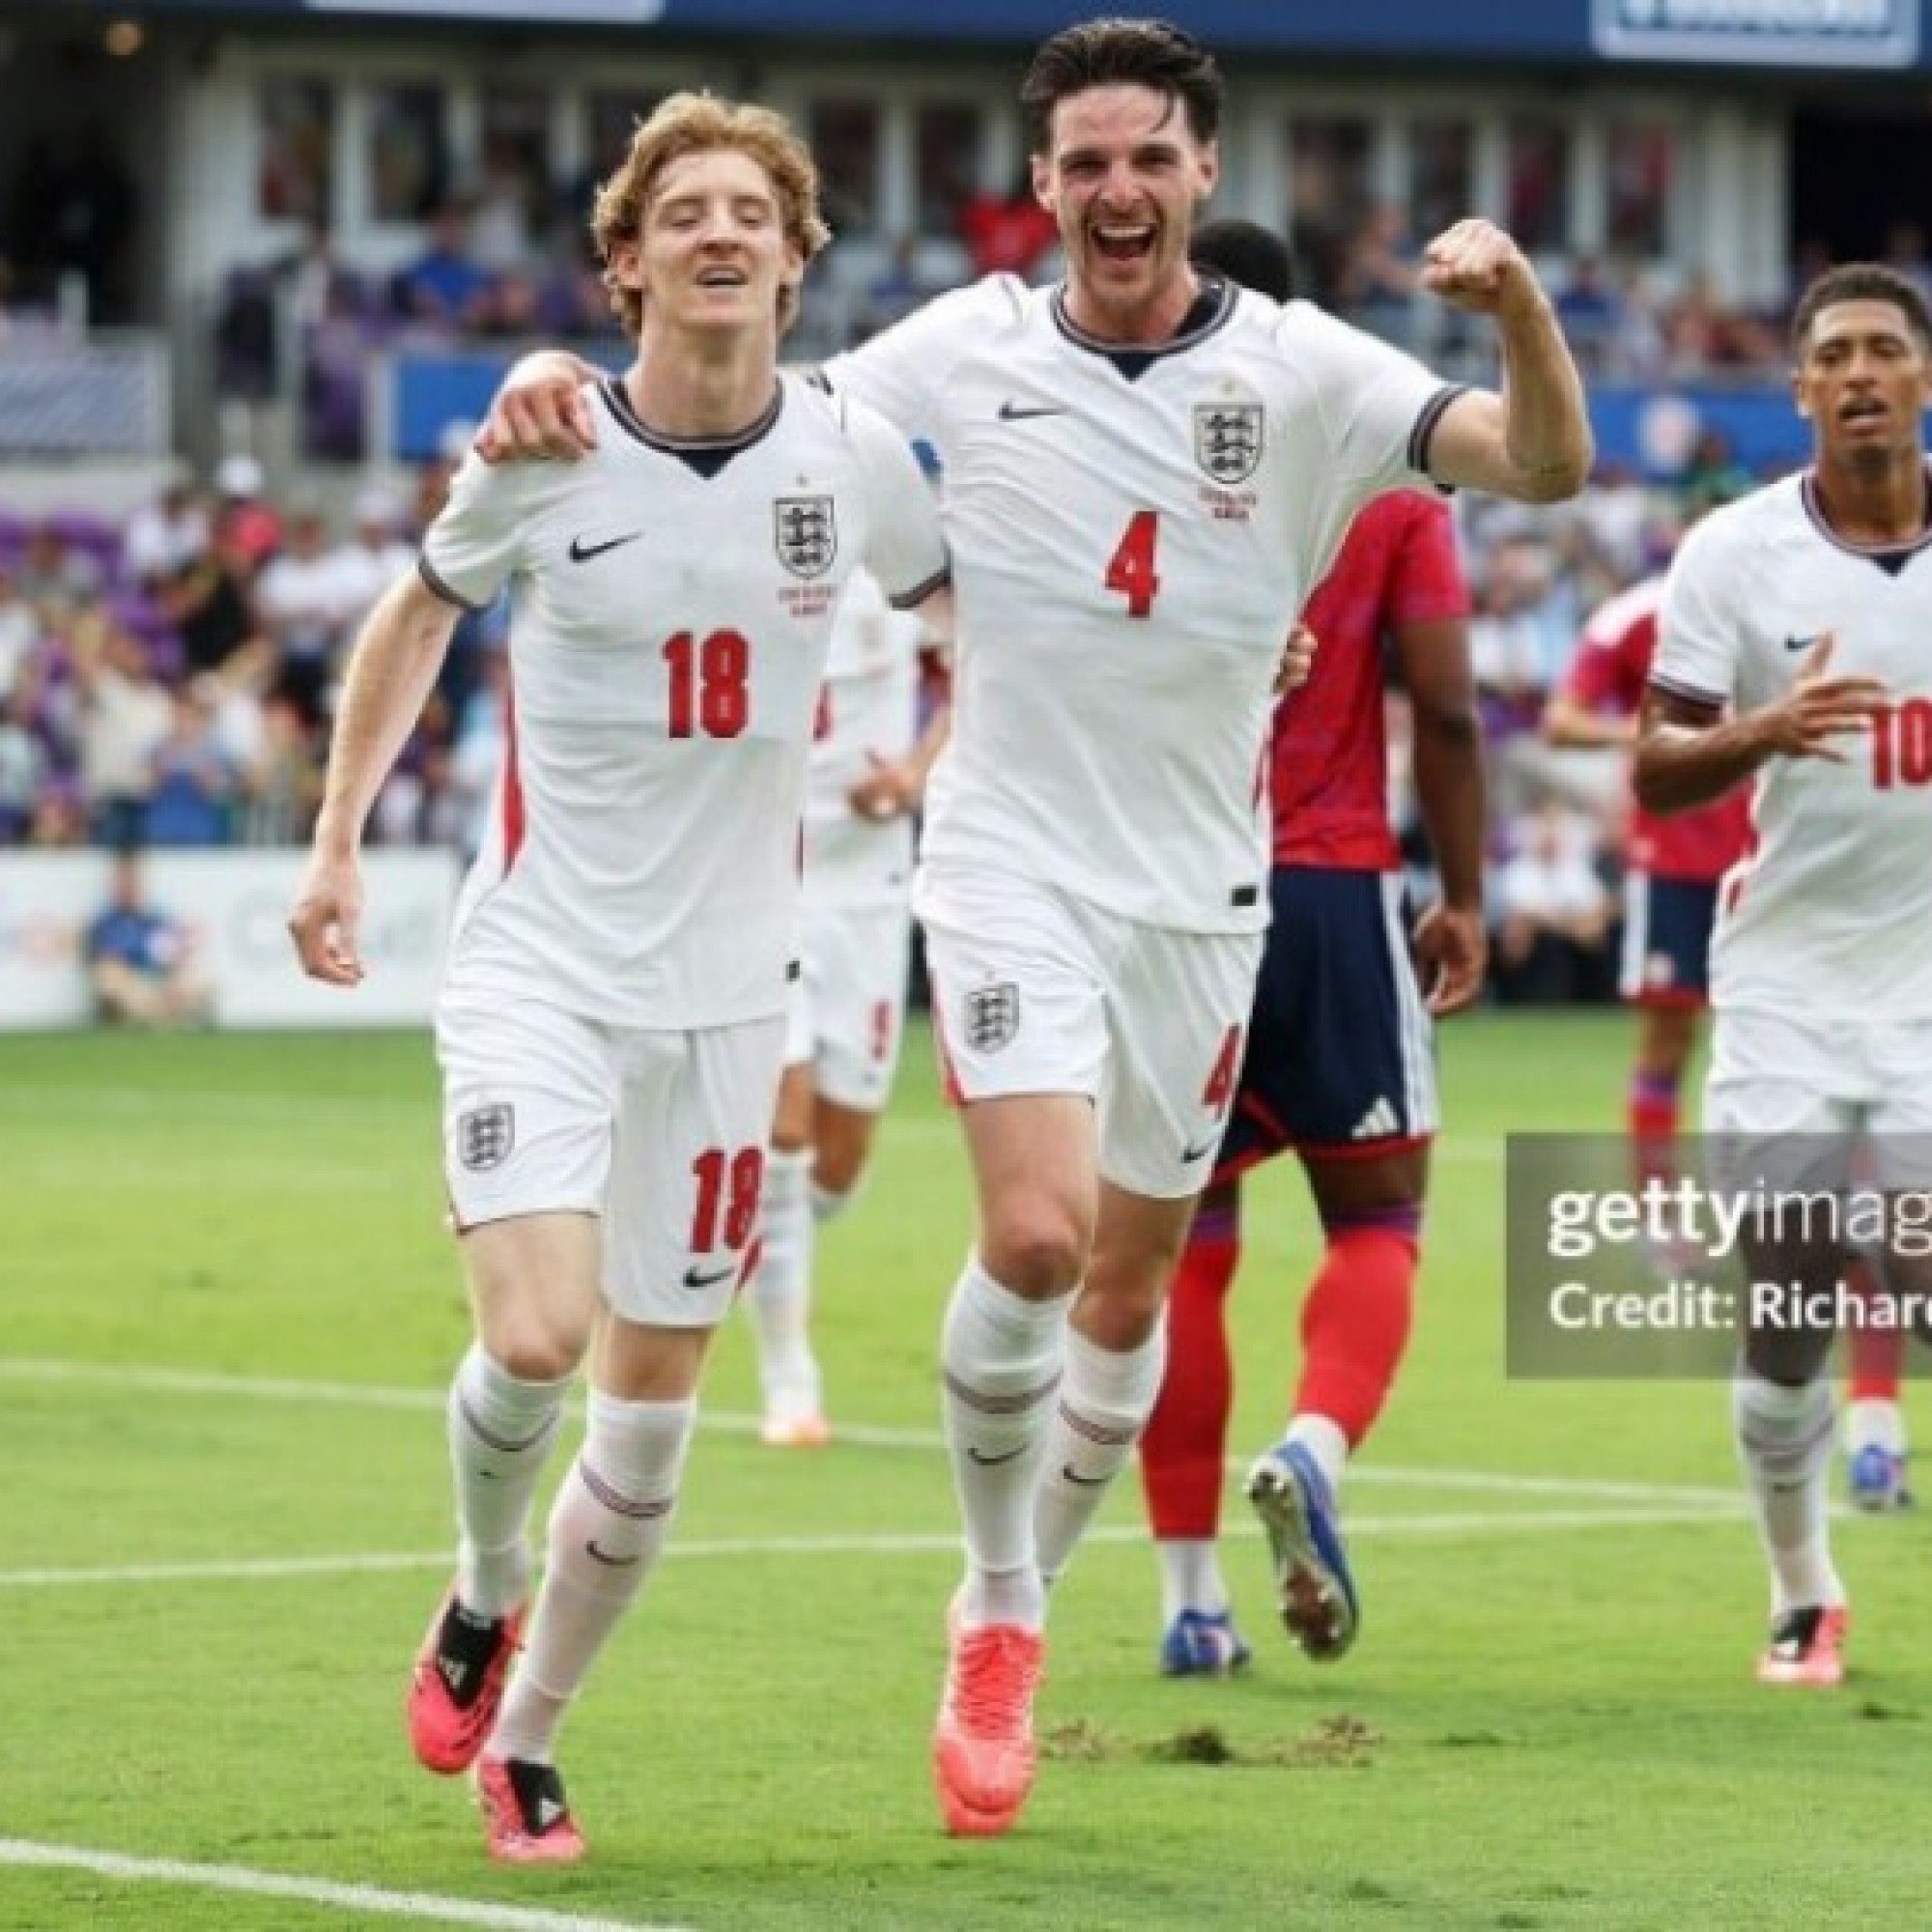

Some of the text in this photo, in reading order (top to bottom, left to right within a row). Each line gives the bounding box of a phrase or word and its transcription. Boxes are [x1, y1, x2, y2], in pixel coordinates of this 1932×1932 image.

[1104, 510, 1160, 620] 4
[662, 628, 749, 739] 18
[1870, 696, 1932, 792] 10
[690, 1145, 763, 1254] 18
